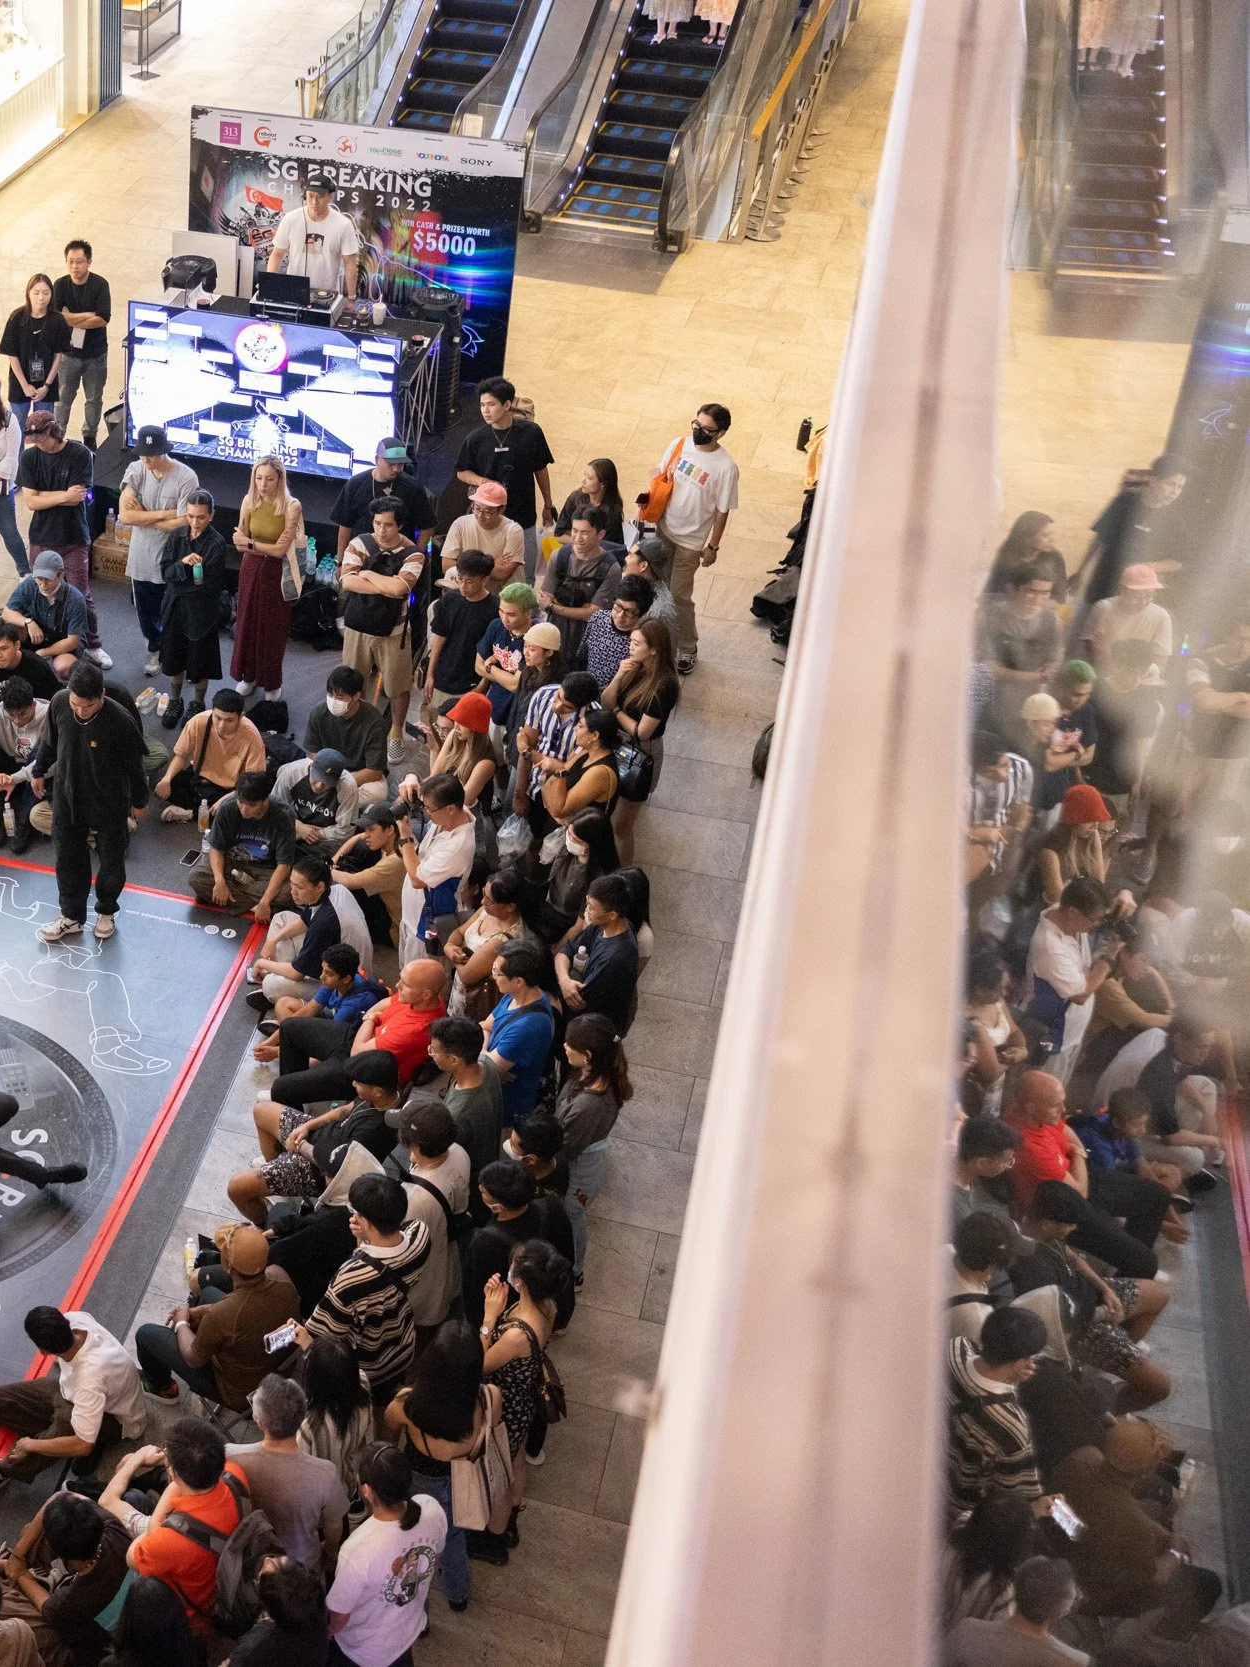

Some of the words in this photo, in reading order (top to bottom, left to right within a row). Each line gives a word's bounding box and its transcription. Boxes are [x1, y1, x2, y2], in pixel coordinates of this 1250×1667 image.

[223, 126, 238, 137] 313
[289, 142, 322, 150] OAKLEY
[460, 157, 493, 167] SONY
[267, 181, 360, 204] CHPS
[375, 194, 431, 212] 2022
[401, 218, 415, 227] WIN
[416, 219, 434, 230] CASH
[435, 222, 441, 230] &
[442, 223, 465, 233] PRIZES
[466, 227, 491, 237] WORTH
[413, 228, 476, 257] $5000
